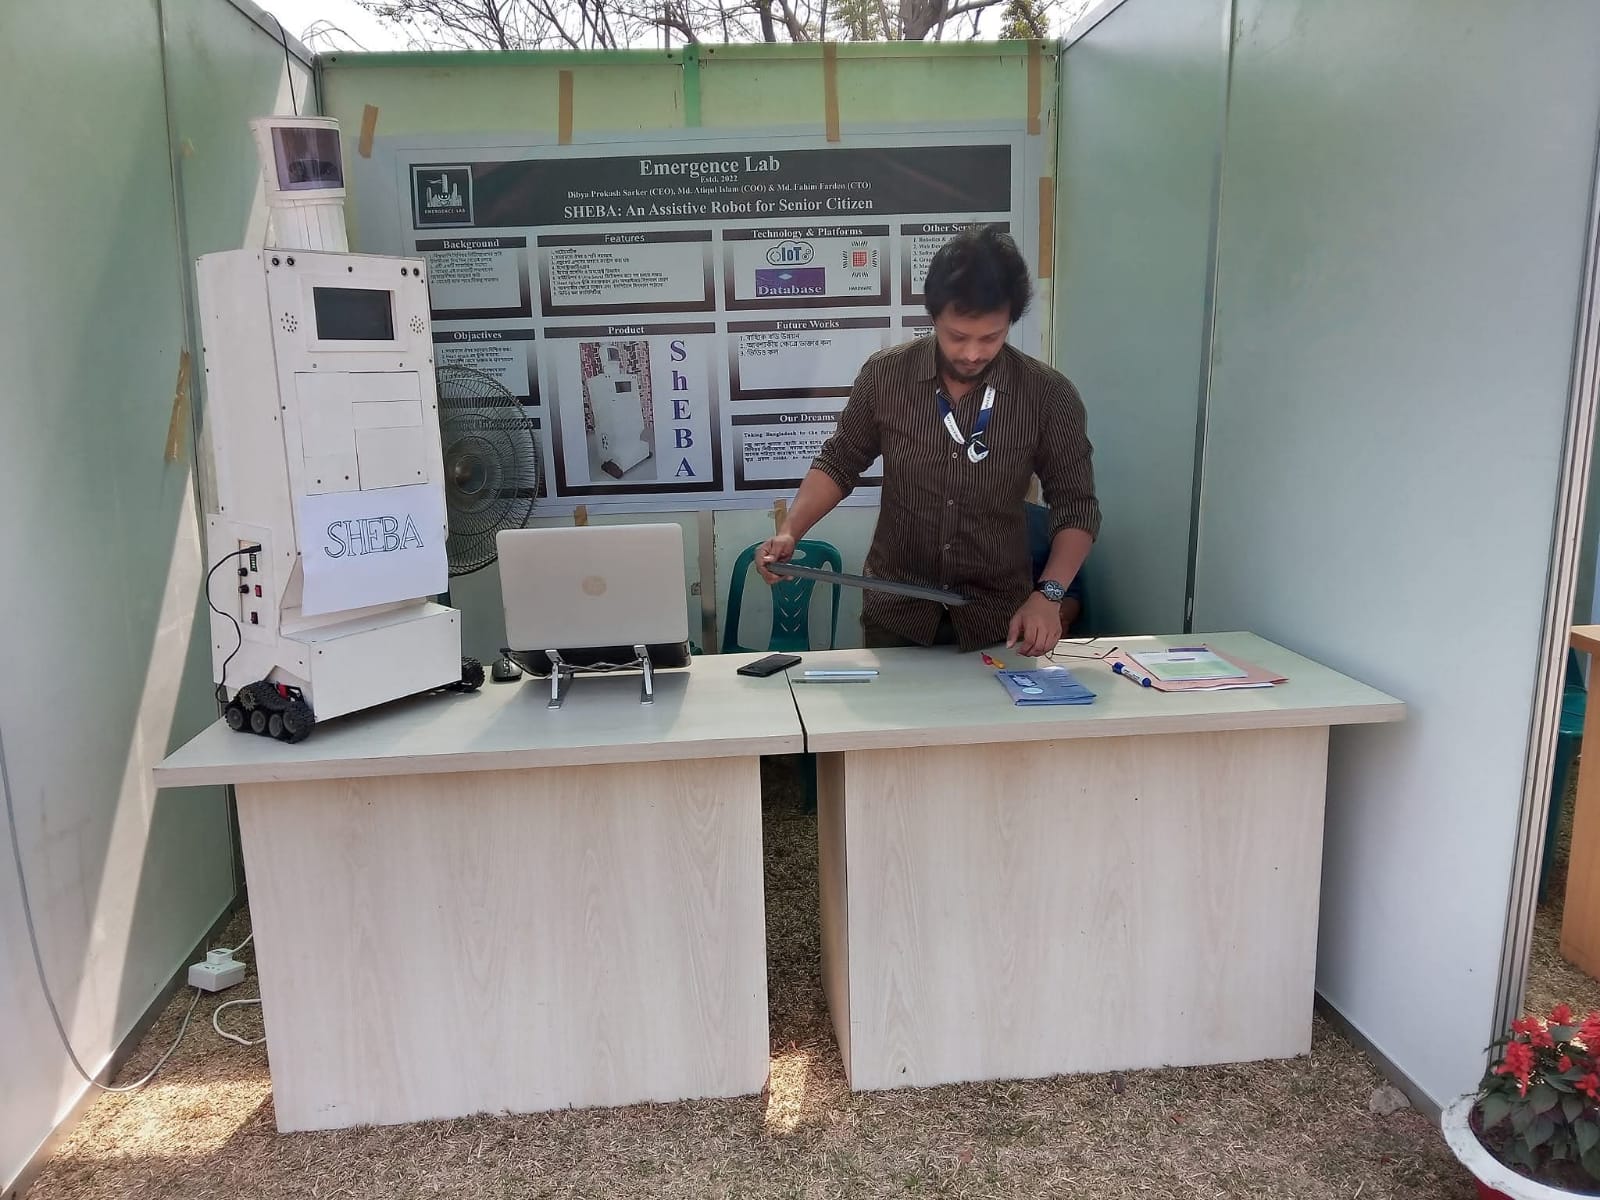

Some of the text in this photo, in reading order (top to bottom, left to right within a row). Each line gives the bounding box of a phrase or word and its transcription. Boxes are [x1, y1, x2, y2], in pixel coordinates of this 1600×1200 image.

[639, 155, 781, 178] Emergence Lab
[720, 174, 738, 182] 2022
[567, 190, 589, 200] Dibya
[591, 189, 621, 198] Prokash
[622, 189, 648, 197] Sarker
[649, 187, 676, 197] (CEO),
[678, 187, 693, 195] Md.
[694, 186, 717, 197] Atiqul
[719, 185, 739, 194] Islam
[741, 184, 767, 194] (COO)
[768, 184, 775, 192] &
[778, 184, 793, 192] Md.
[847, 181, 872, 191] (CTO)
[564, 196, 873, 219] SHEBA: An Assistive Robot for Senior Citizen
[751, 226, 863, 240] Technology & Platforms
[922, 223, 949, 233] Other
[604, 233, 645, 242] Features
[443, 239, 500, 249] Background
[781, 246, 802, 262] IoT
[758, 285, 822, 295] Database
[776, 320, 840, 329] Future Works
[608, 326, 645, 335] Product
[779, 414, 835, 423] Our Dreams
[324, 513, 425, 559] SHEBA
